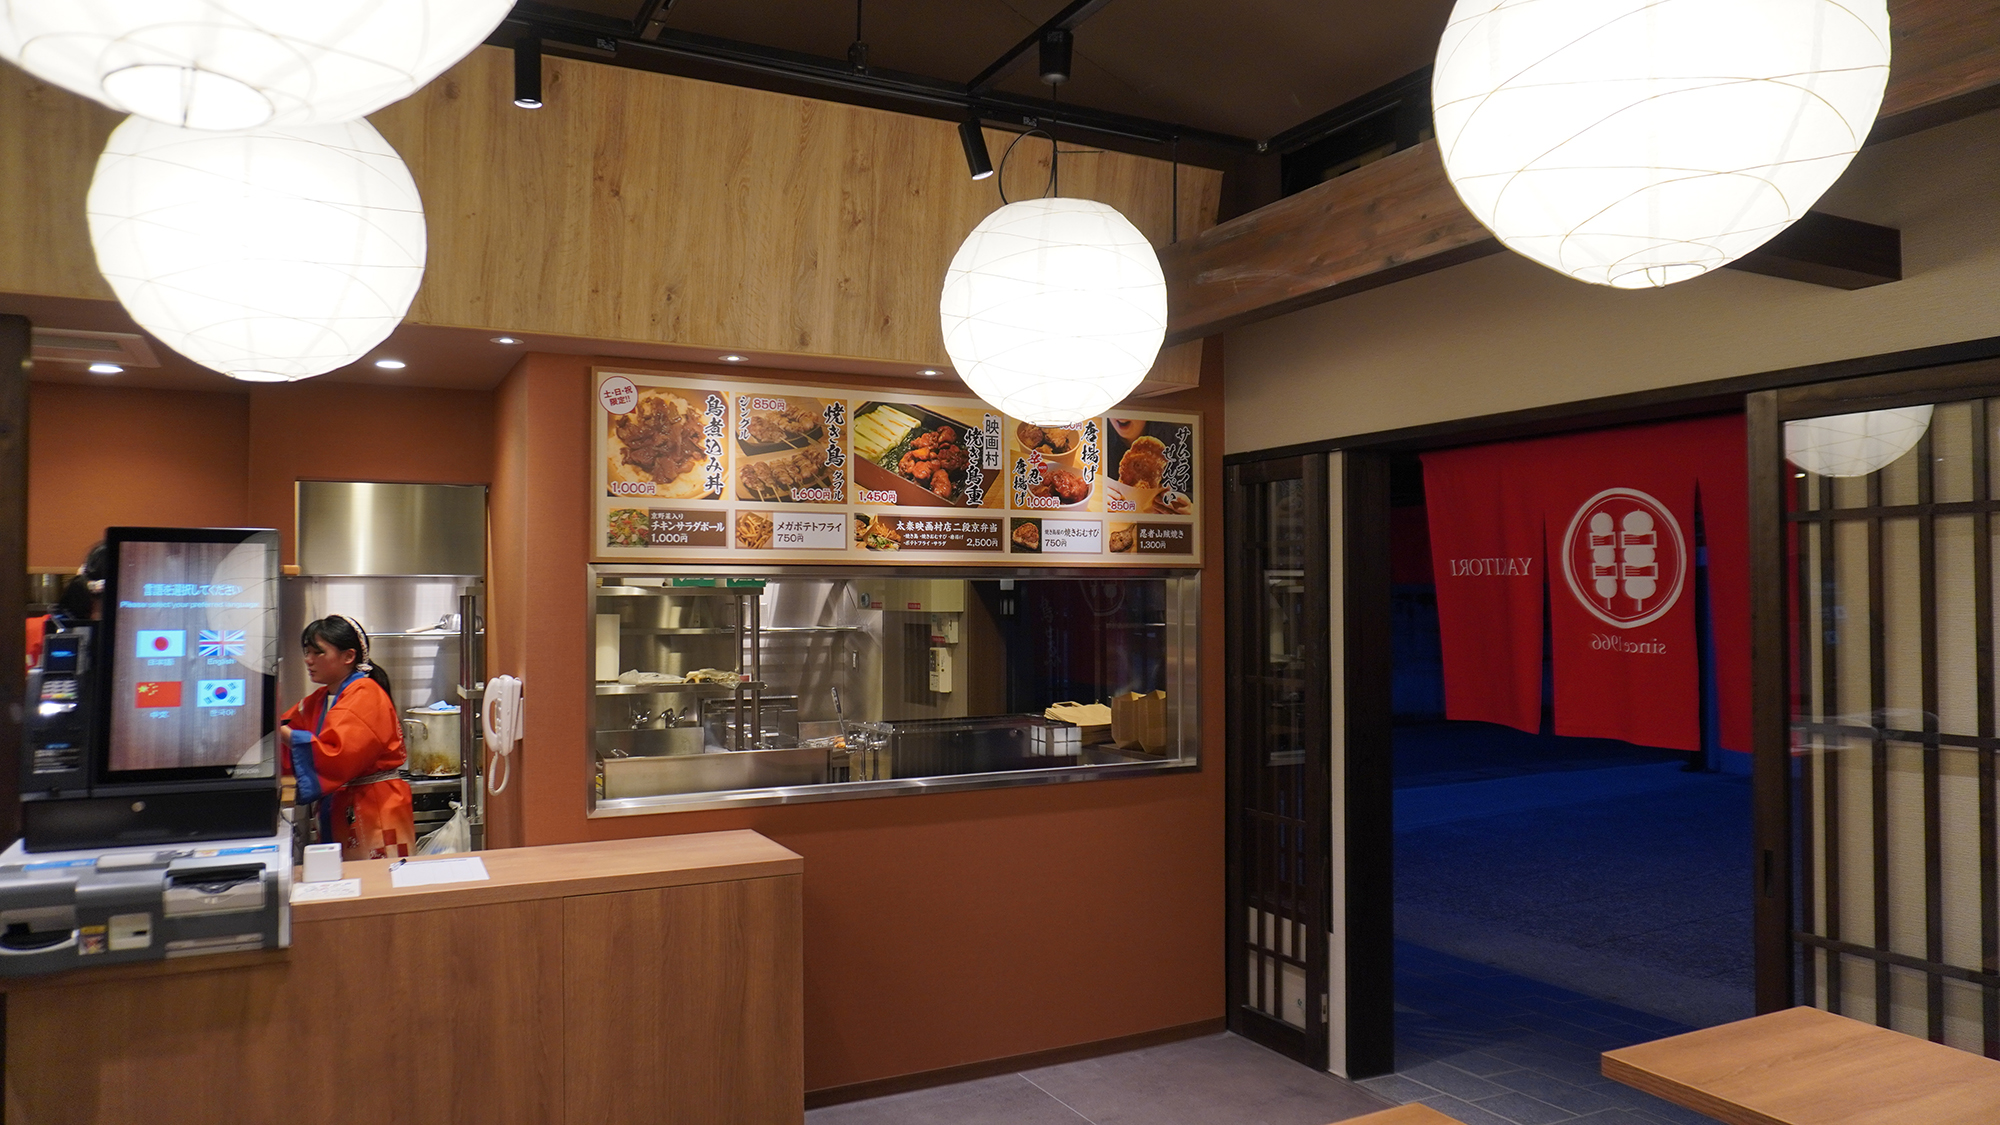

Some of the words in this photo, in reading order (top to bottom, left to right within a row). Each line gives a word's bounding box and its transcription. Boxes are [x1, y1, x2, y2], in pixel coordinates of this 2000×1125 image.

[753, 398, 785, 410] 850円
[739, 396, 751, 440] シングル
[824, 402, 846, 467] 焼き鳥
[705, 395, 725, 494] 鳥煮込み丼
[985, 418, 1000, 467] 映画村
[1081, 421, 1100, 484] 唐揚げ
[1175, 426, 1191, 492] サムライ
[965, 426, 984, 505] 焼き鳥重
[612, 481, 656, 495] 1,000円
[833, 470, 844, 500] ダブル
[1012, 458, 1028, 507] 唐揚げ
[791, 488, 831, 500] 1,600円
[858, 490, 897, 503] 1,450円
[1026, 497, 1060, 508] 1,000円
[1110, 501, 1136, 511] 850円
[651, 520, 725, 532] チキンサラダボール
[776, 521, 842, 533] メガポテトフライ
[896, 520, 998, 533] 太秦映画村店二段京弁当
[651, 533, 688, 543] 1,000円
[777, 534, 804, 543] 750円
[966, 538, 998, 547] 2,500円
[1045, 539, 1067, 547] 750円
[1140, 540, 1166, 549] 1,300円
[207, 658, 236, 667] English
